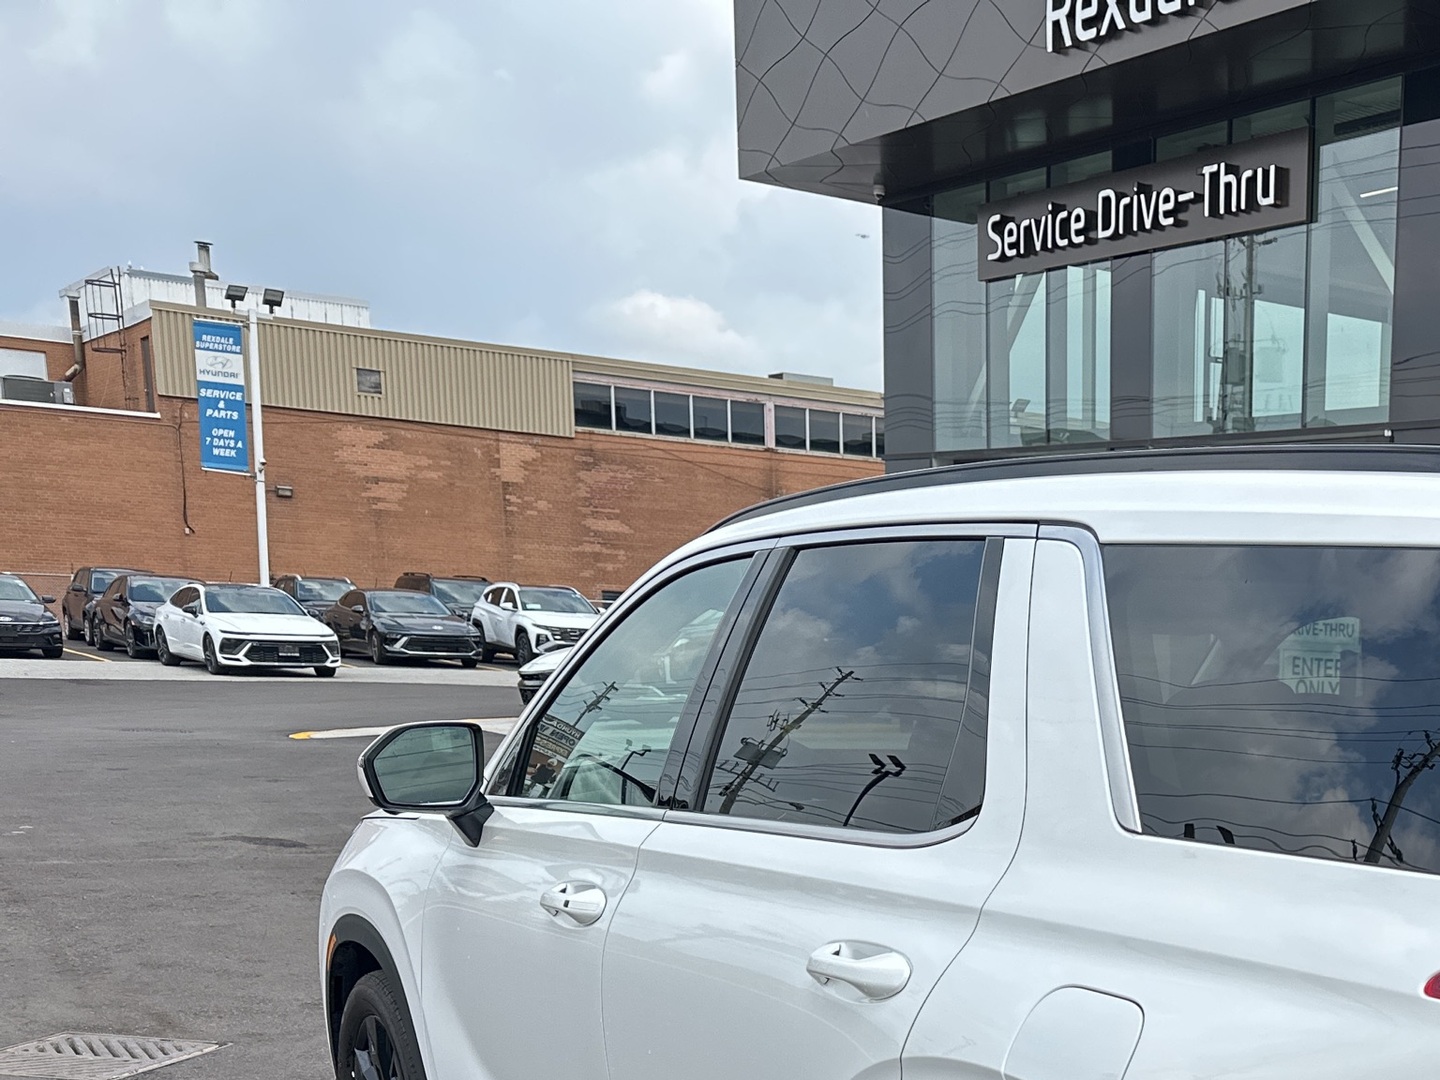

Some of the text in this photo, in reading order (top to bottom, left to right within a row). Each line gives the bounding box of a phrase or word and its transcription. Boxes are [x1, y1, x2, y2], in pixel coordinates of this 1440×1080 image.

[987, 162, 1276, 261] Service Drive-Thru
[202, 334, 234, 345] REXDALE
[196, 341, 241, 353] SUPERSTORE
[199, 369, 239, 379] HYUNDAI
[200, 388, 243, 400] SERVICE
[218, 400, 225, 409] &
[206, 409, 238, 420] PARTS
[212, 428, 235, 438] OPEN
[205, 437, 211, 445] 7
[213, 438, 235, 447] DAYS
[212, 447, 236, 458] WEEK
